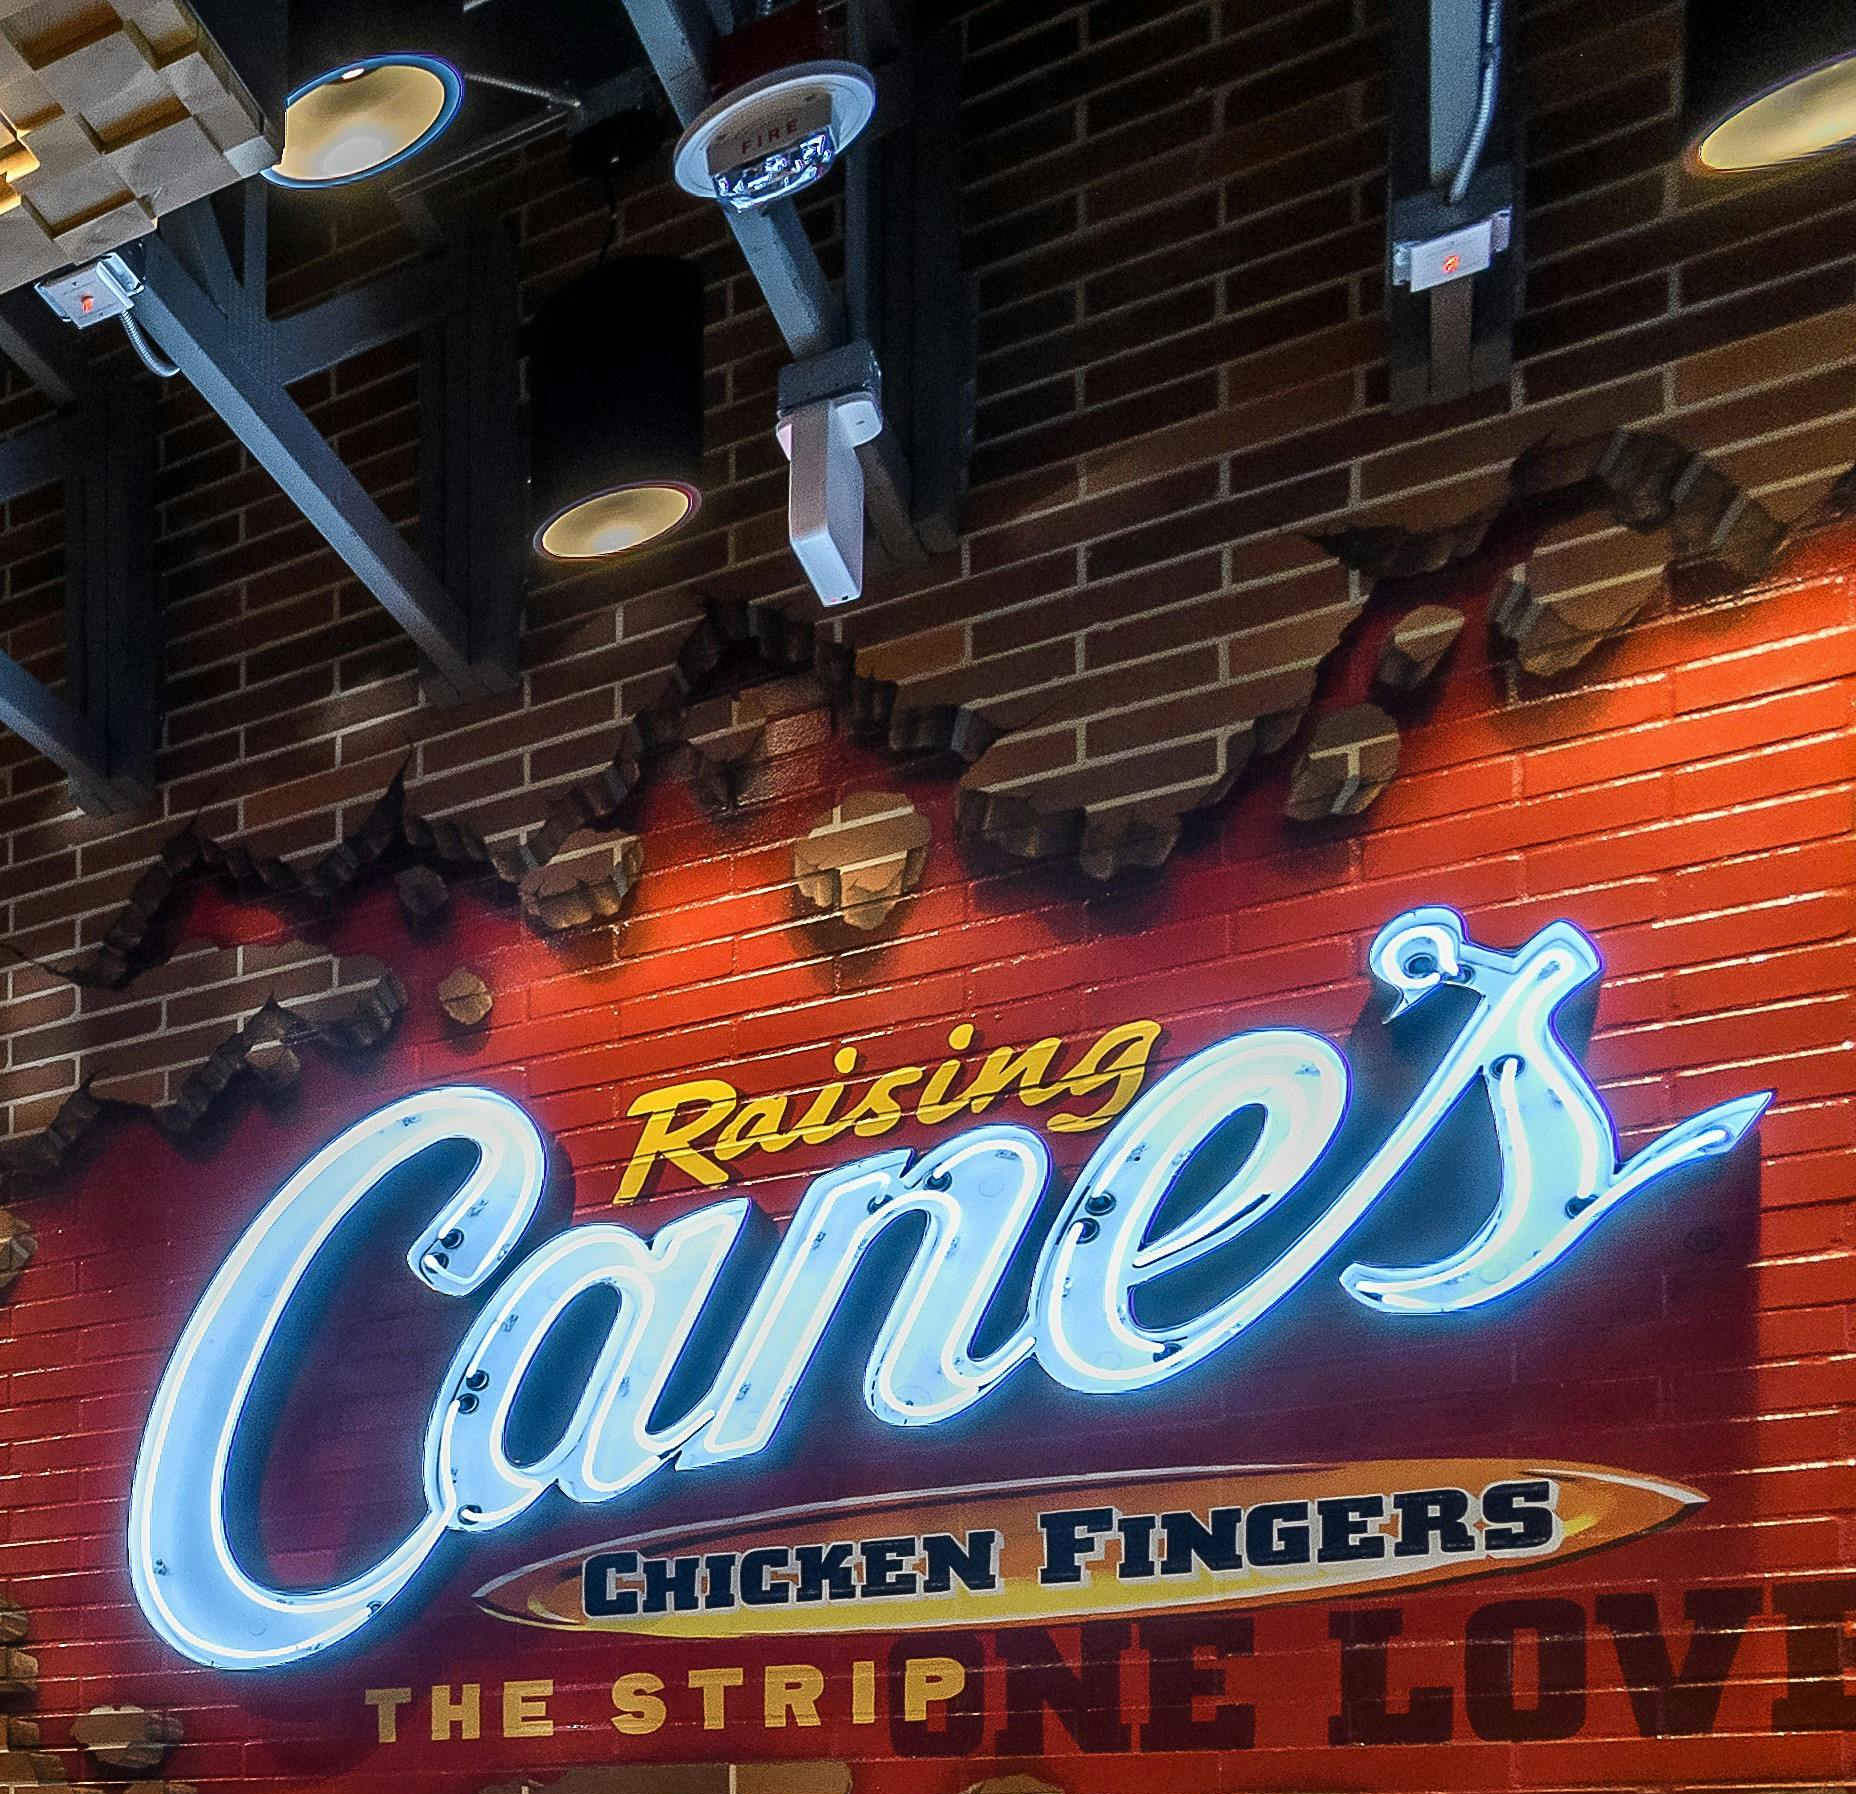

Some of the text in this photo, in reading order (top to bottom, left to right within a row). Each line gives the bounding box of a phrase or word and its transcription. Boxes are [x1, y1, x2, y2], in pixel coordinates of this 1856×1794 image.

[742, 119, 799, 155] FIRE
[613, 1019, 1163, 1206] Raising
[127, 905, 1775, 1672] Cane's
[582, 1480, 1558, 1621] CHICKEN FINGERS
[365, 1657, 968, 1746] THE STRIP
[890, 1612, 1256, 1759] ONE
